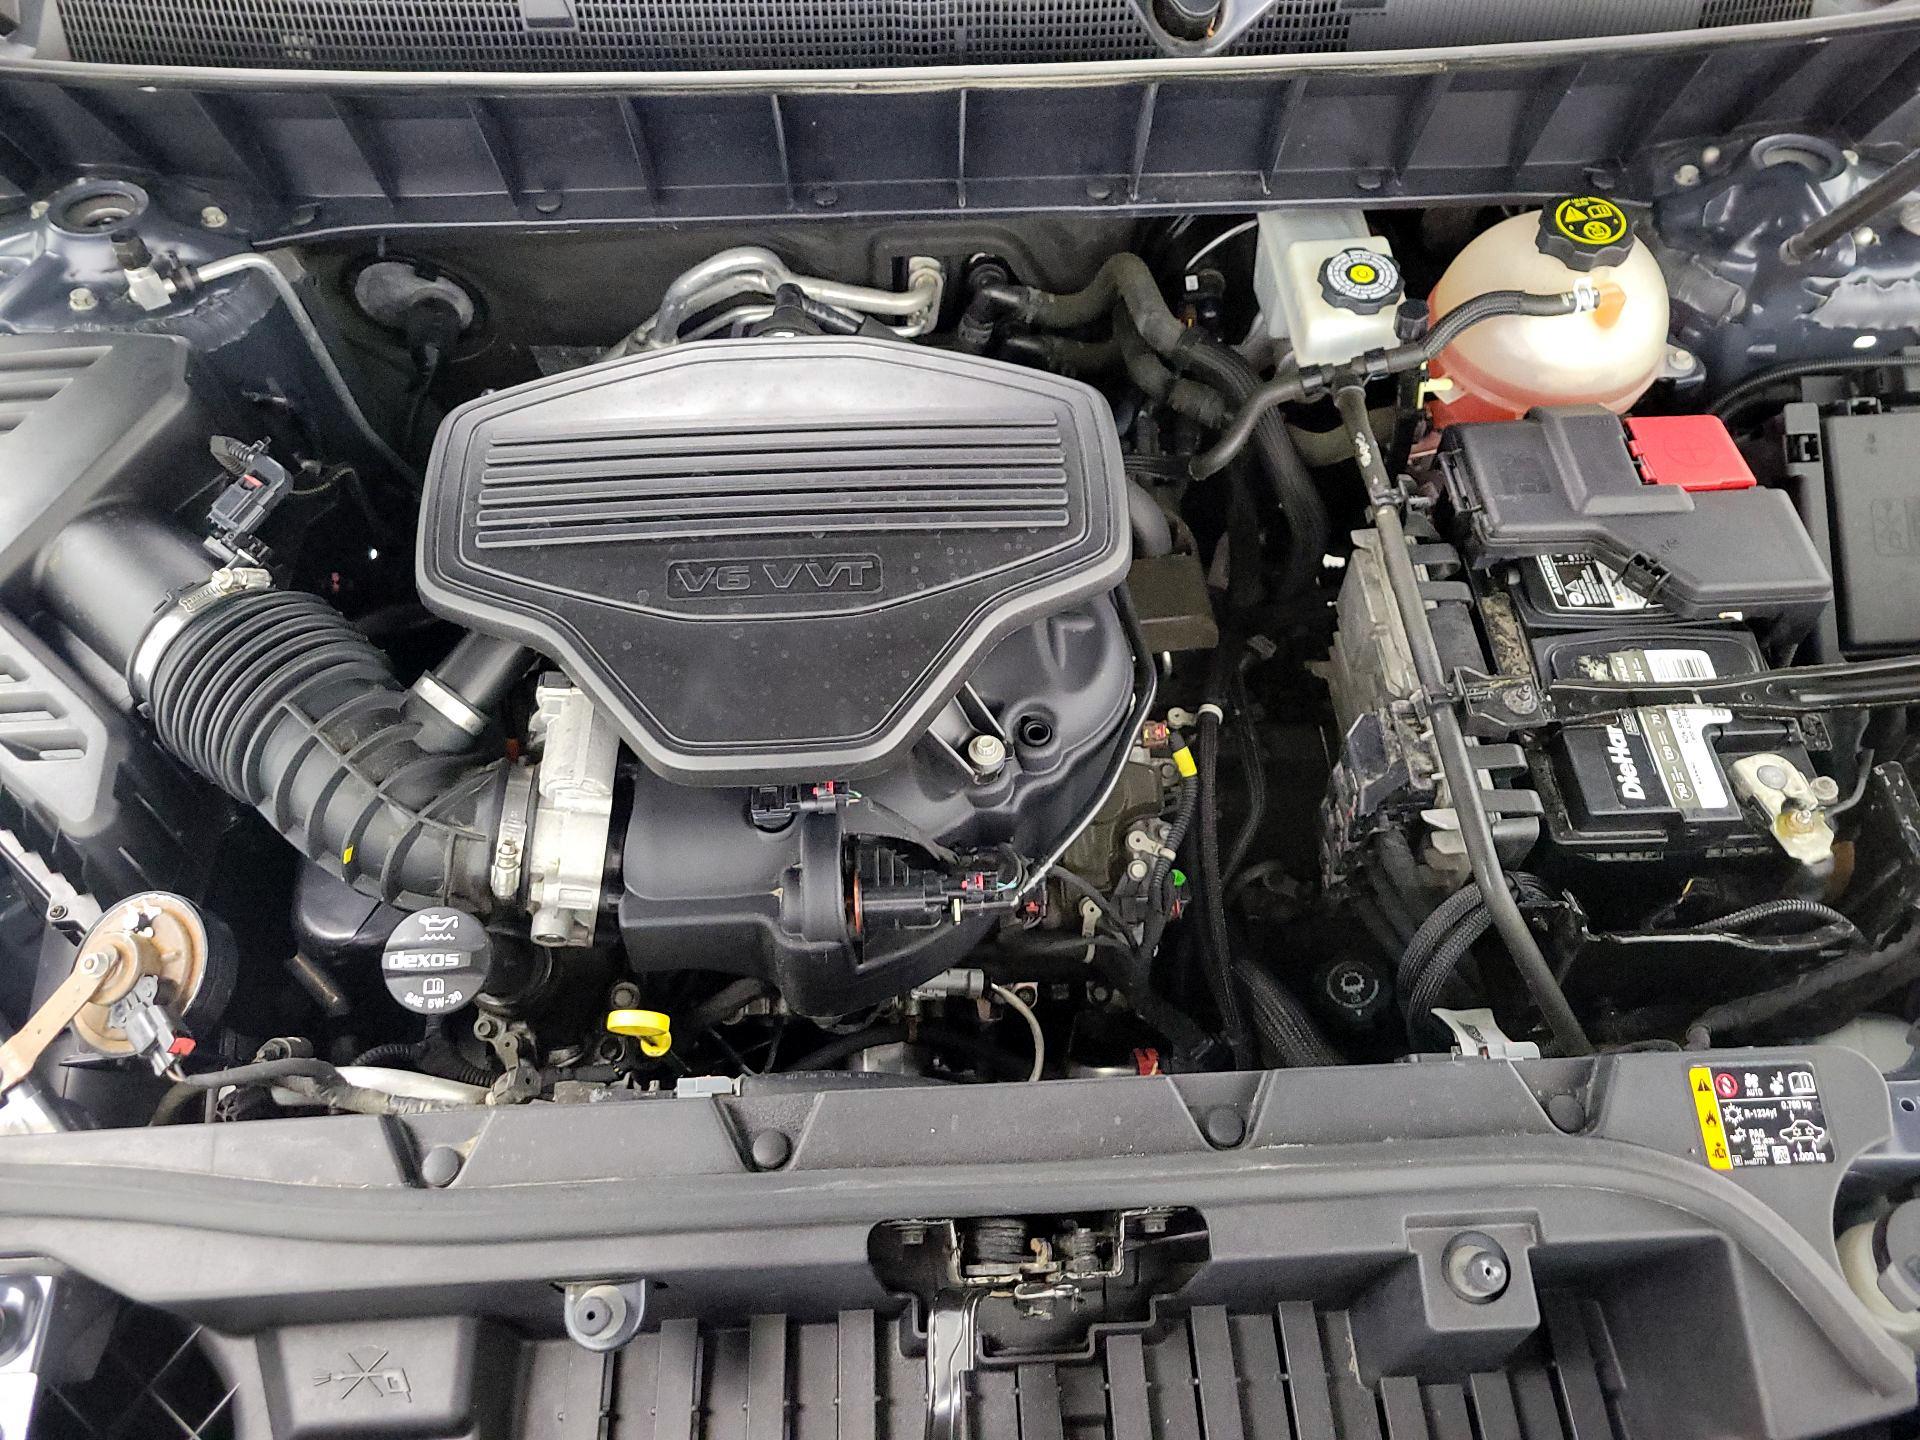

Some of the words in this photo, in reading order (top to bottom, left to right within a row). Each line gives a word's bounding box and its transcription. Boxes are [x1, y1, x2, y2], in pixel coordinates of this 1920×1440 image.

[676, 566, 750, 592] V6
[763, 561, 874, 588] VVT
[1606, 716, 1646, 800] DieHar
[388, 951, 461, 968] dexos
[404, 992, 425, 1008] SAE
[427, 991, 463, 1009] 5W-30
[1746, 1087, 1764, 1097] AUTO
[1743, 1107, 1778, 1120] R-1234yf
